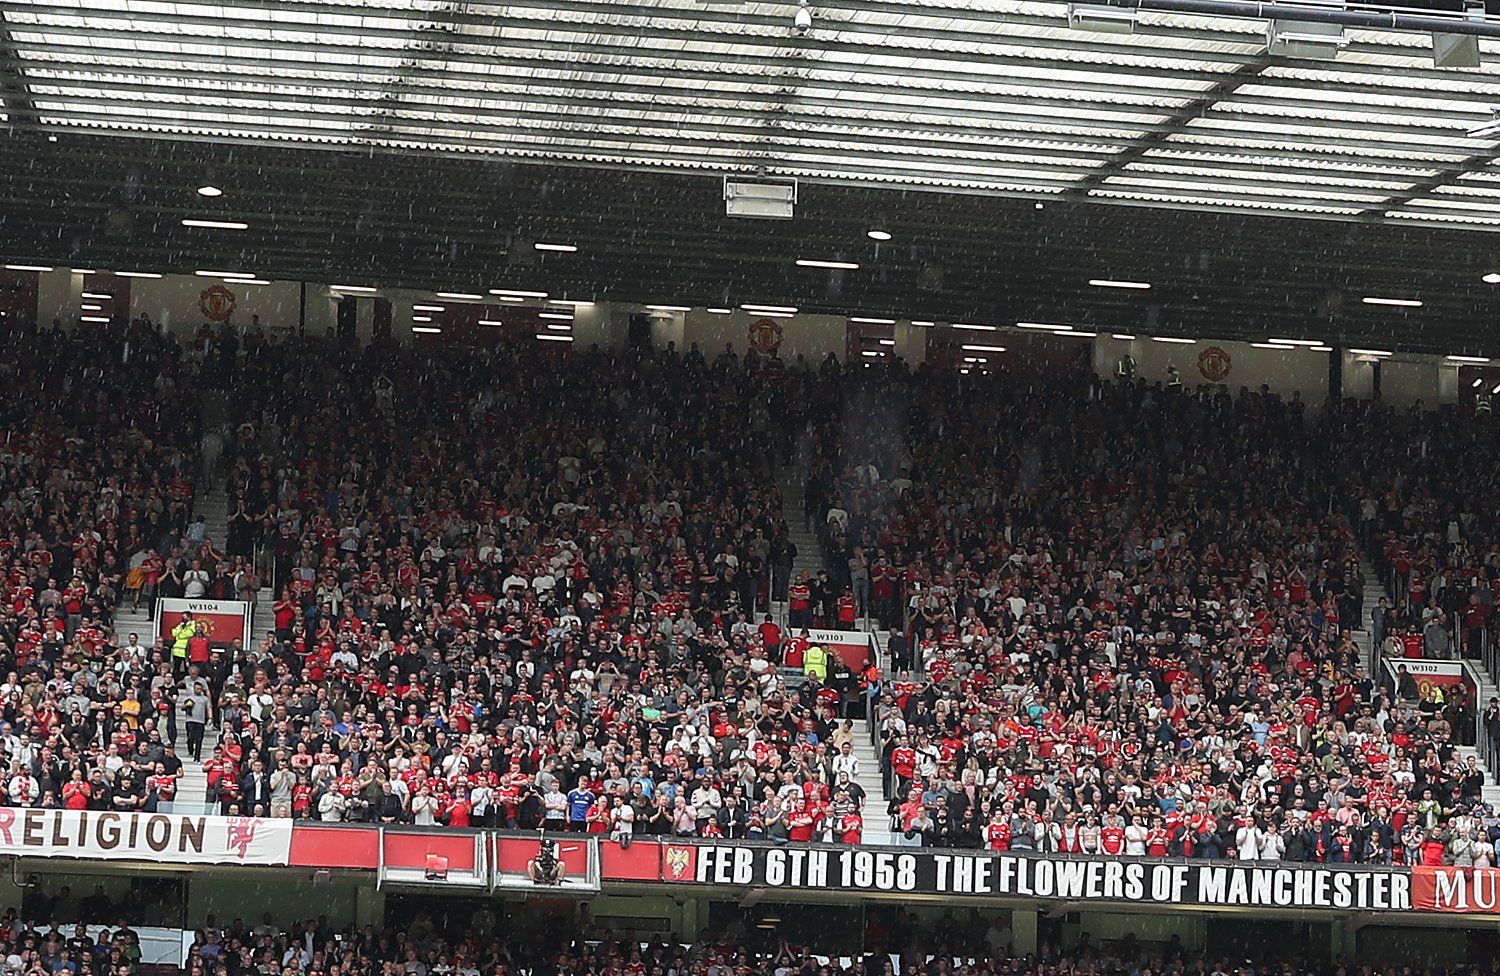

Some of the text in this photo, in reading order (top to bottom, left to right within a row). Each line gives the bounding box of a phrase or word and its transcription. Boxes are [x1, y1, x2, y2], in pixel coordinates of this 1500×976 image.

[188, 603, 218, 611] W3104
[0, 809, 207, 853] RELIGION
[697, 847, 1412, 911] FEB 6TH 1958 THE FLOWERS OF MANCHESTER
